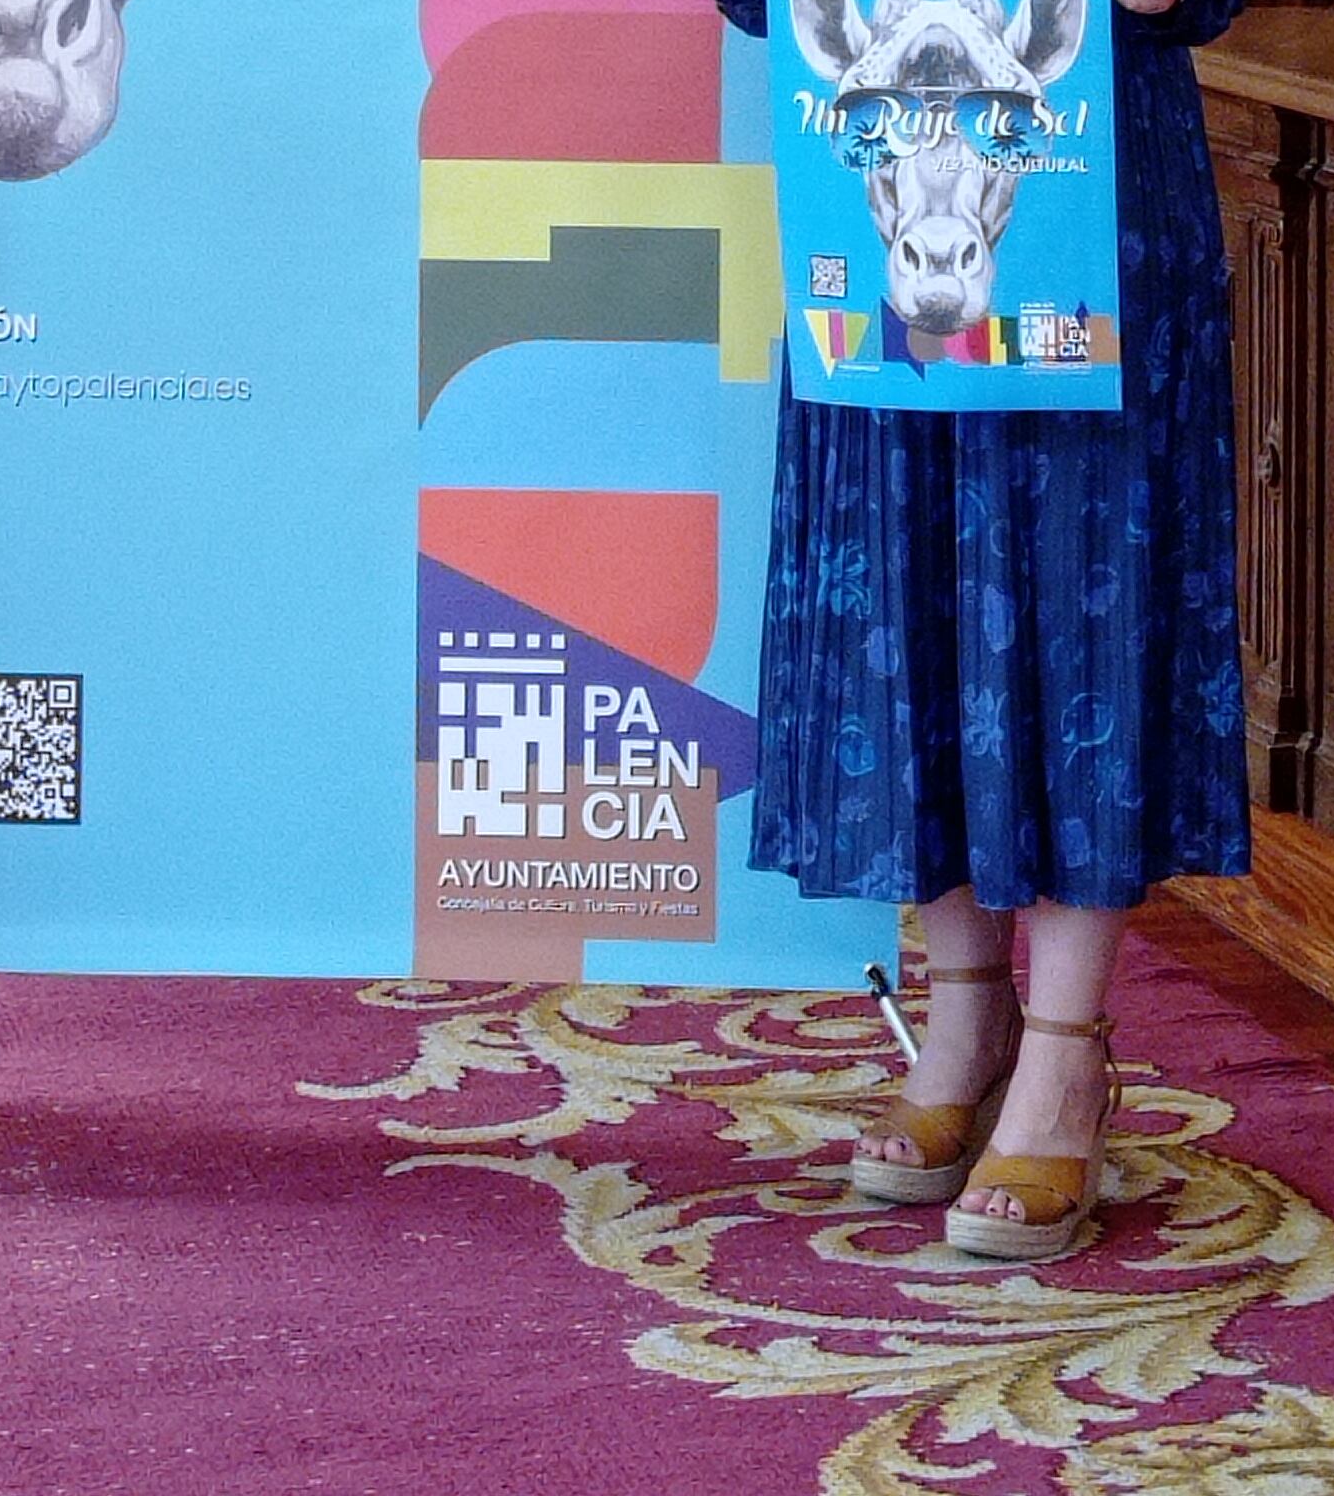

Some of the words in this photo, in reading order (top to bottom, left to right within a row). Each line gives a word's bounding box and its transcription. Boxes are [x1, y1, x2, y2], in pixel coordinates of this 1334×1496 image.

[793, 91, 849, 135] Un
[583, 686, 661, 734] PA
[583, 739, 701, 789] LEN
[581, 791, 687, 841] CIA
[437, 858, 700, 892] AYUNTAMIENTO
